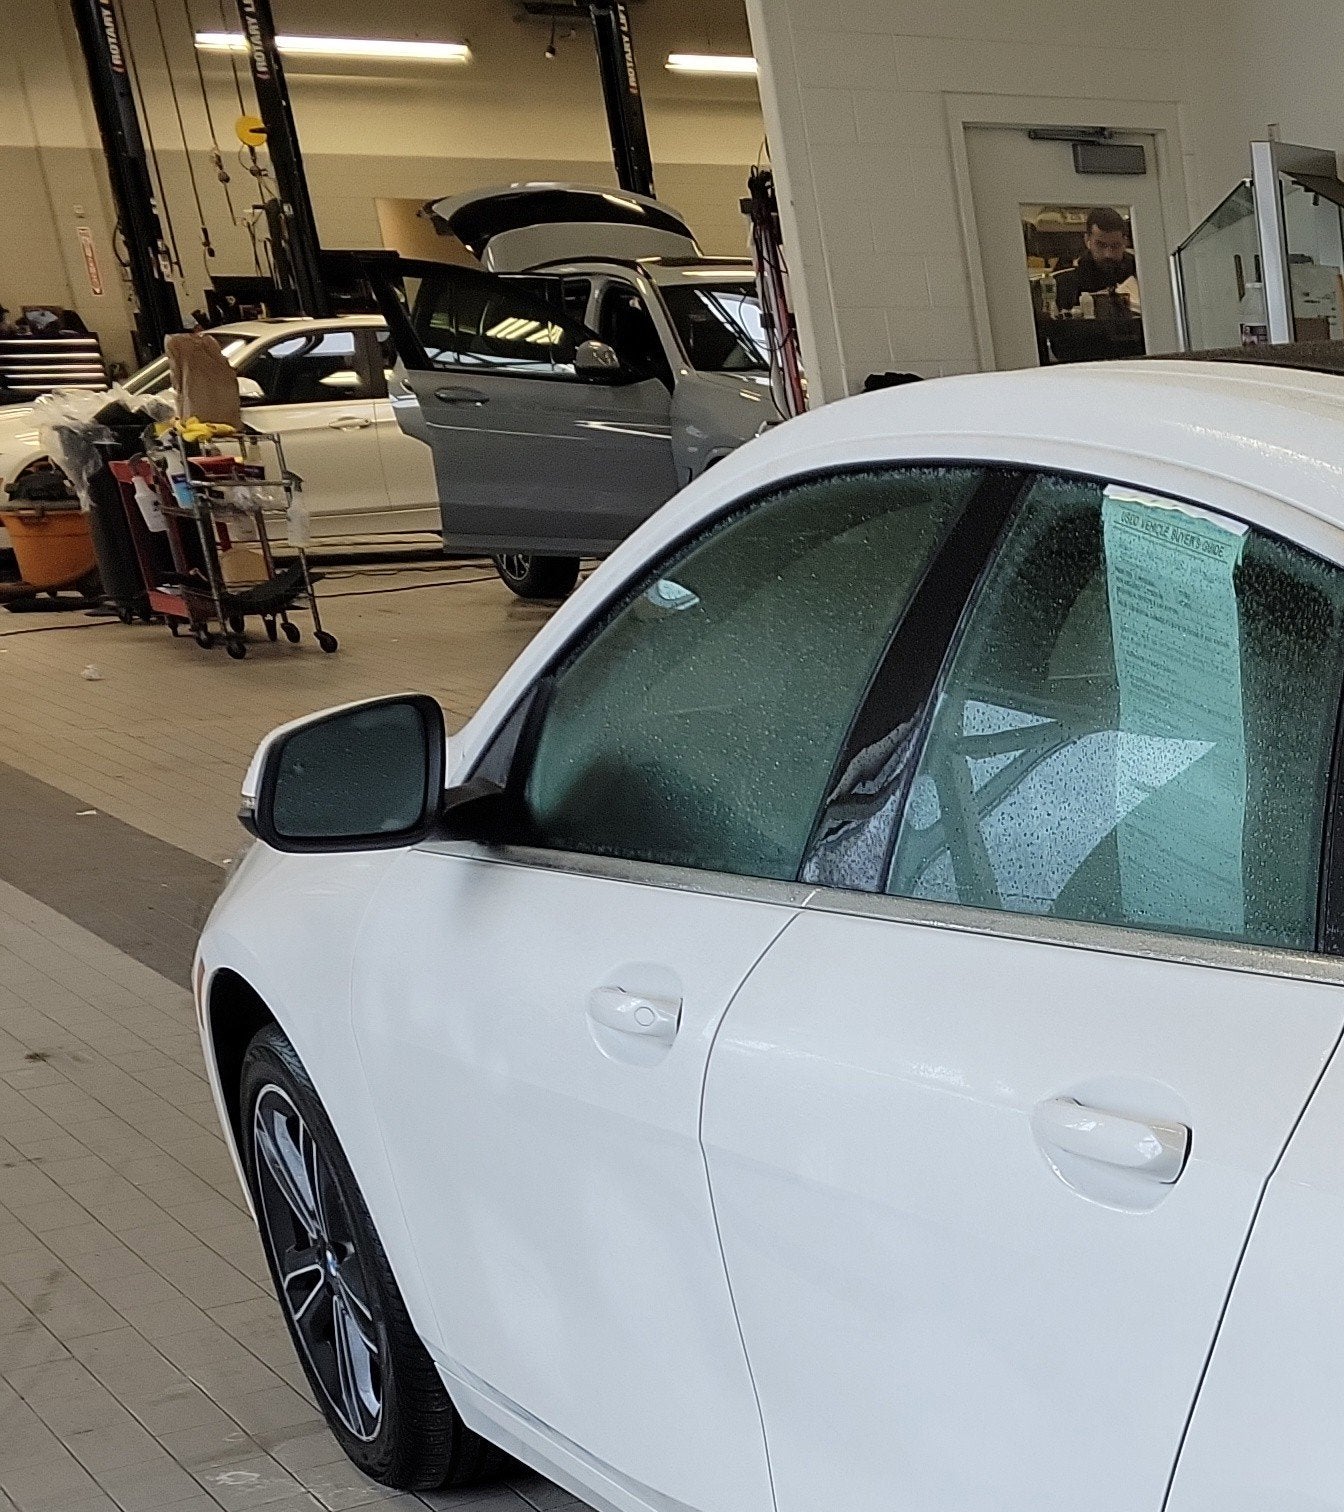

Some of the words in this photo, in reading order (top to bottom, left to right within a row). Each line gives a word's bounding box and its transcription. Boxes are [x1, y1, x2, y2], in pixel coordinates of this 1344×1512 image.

[246, 16, 269, 72] ROTARY
[622, 35, 637, 87] ROTARY
[1140, 517, 1170, 538] VEHICLE
[1171, 527, 1201, 550] BUYER'S
[1202, 539, 1225, 558] GUIDE
